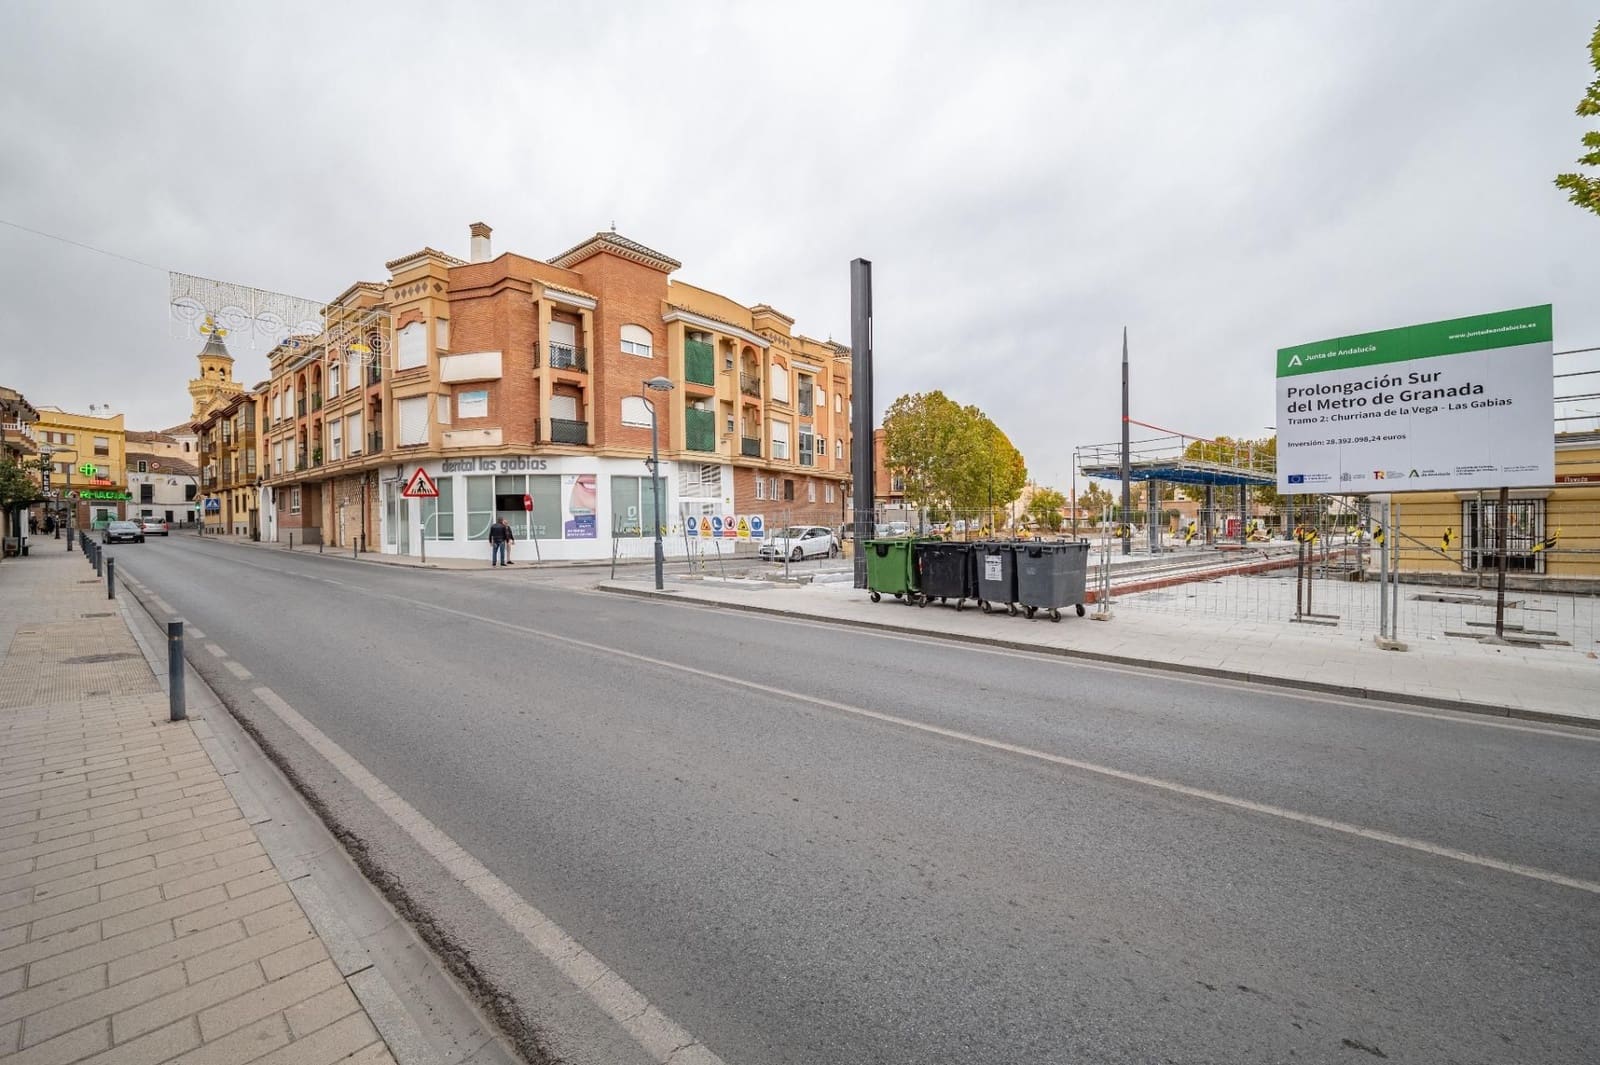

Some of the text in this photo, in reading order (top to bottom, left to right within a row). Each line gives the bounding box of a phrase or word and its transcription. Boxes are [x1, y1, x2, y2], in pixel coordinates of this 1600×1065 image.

[1305, 353, 1326, 361] Junta
[1338, 344, 1377, 356] Andalucía
[1287, 372, 1442, 398] Prolongación Sur
[1287, 382, 1484, 413] del Metro de Granada
[1288, 416, 1318, 425] Tramo
[1320, 415, 1329, 423] 2:
[1331, 410, 1381, 422] Churriana
[1384, 409, 1397, 417] de
[1400, 407, 1409, 415] la
[1411, 405, 1438, 414] Vega
[1448, 402, 1468, 411] Las
[1471, 398, 1513, 409] Gabias
[1288, 440, 1325, 448] Inversión:
[442, 456, 547, 474] dental las gabias
